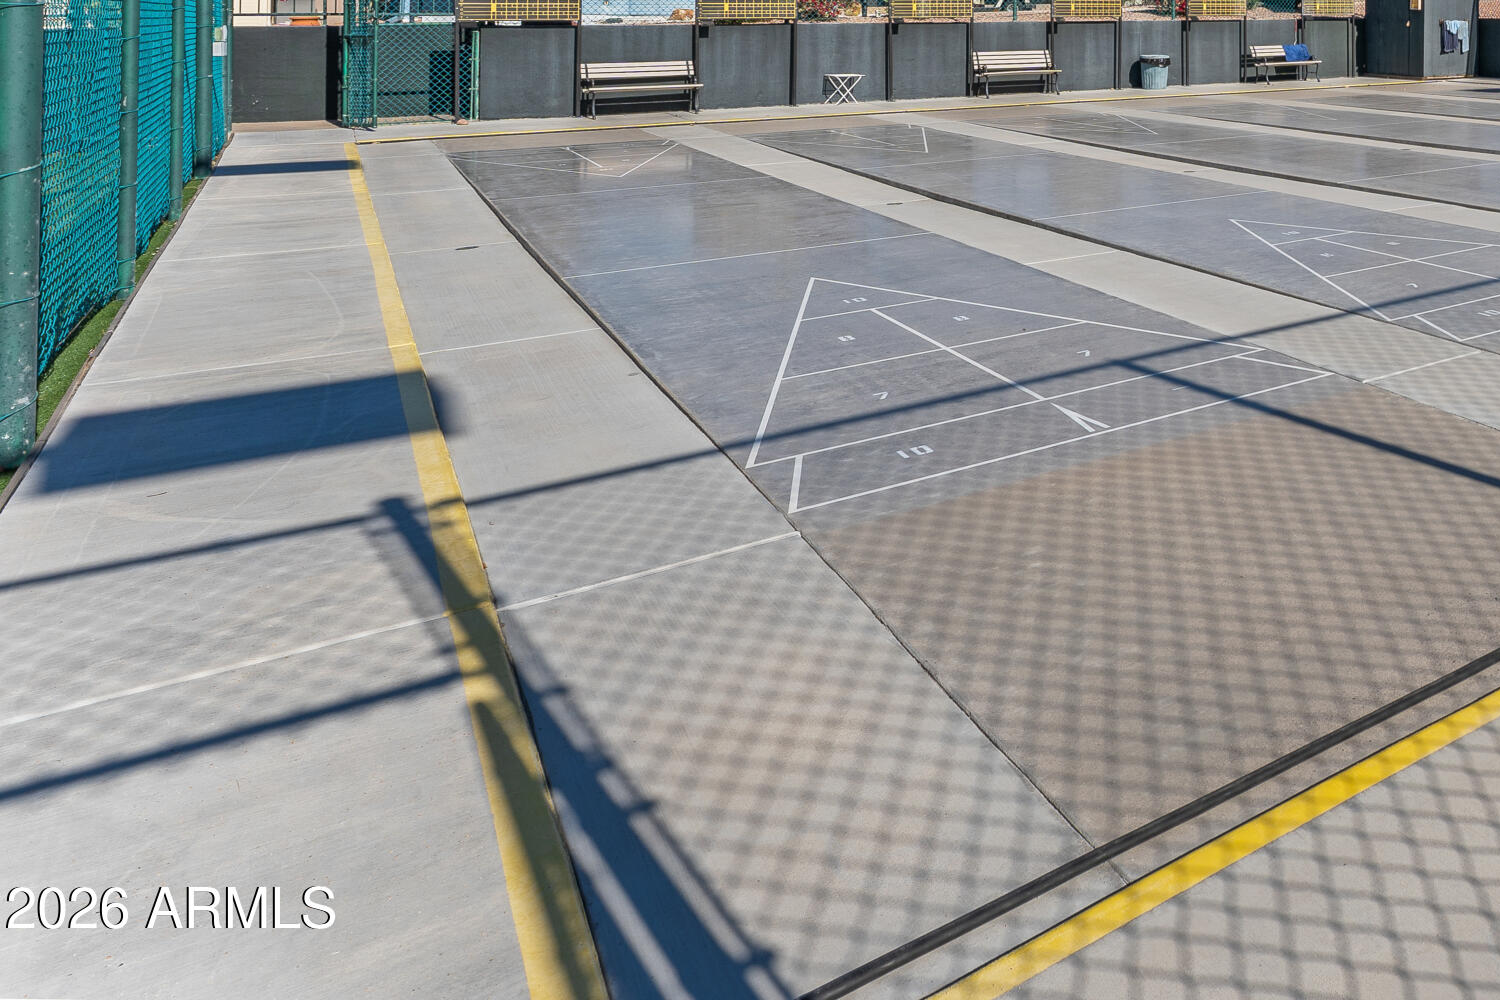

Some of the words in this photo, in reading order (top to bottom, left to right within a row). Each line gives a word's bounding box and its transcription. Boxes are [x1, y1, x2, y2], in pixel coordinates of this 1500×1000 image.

[842, 296, 869, 304] 10
[1076, 349, 1091, 357] 7
[872, 391, 889, 400] 7
[896, 444, 934, 459] 10
